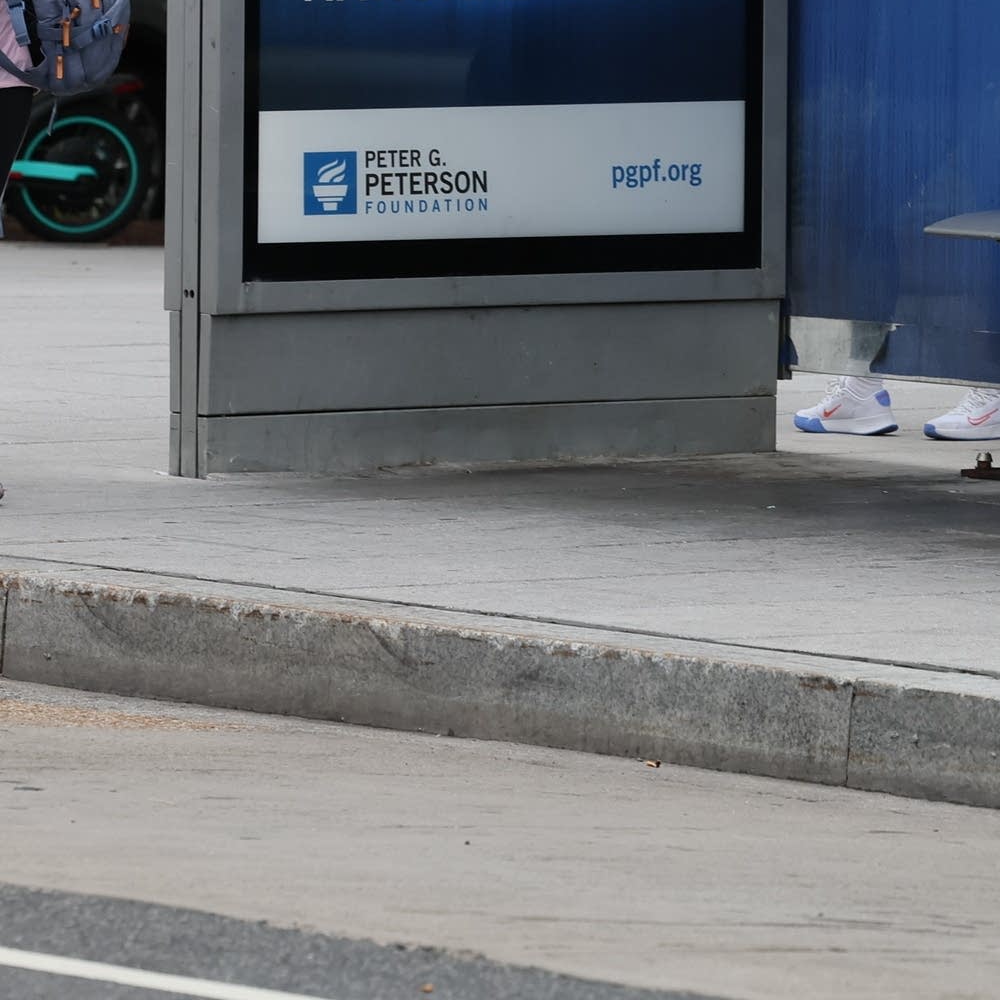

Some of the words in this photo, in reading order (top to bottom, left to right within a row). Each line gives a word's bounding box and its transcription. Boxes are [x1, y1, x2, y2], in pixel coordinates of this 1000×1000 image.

[365, 149, 421, 169] PETER
[428, 148, 447, 167] G.
[365, 170, 488, 197] PETERSON
[611, 158, 703, 190] pgpf.org
[365, 197, 488, 215] FOUNDATION
